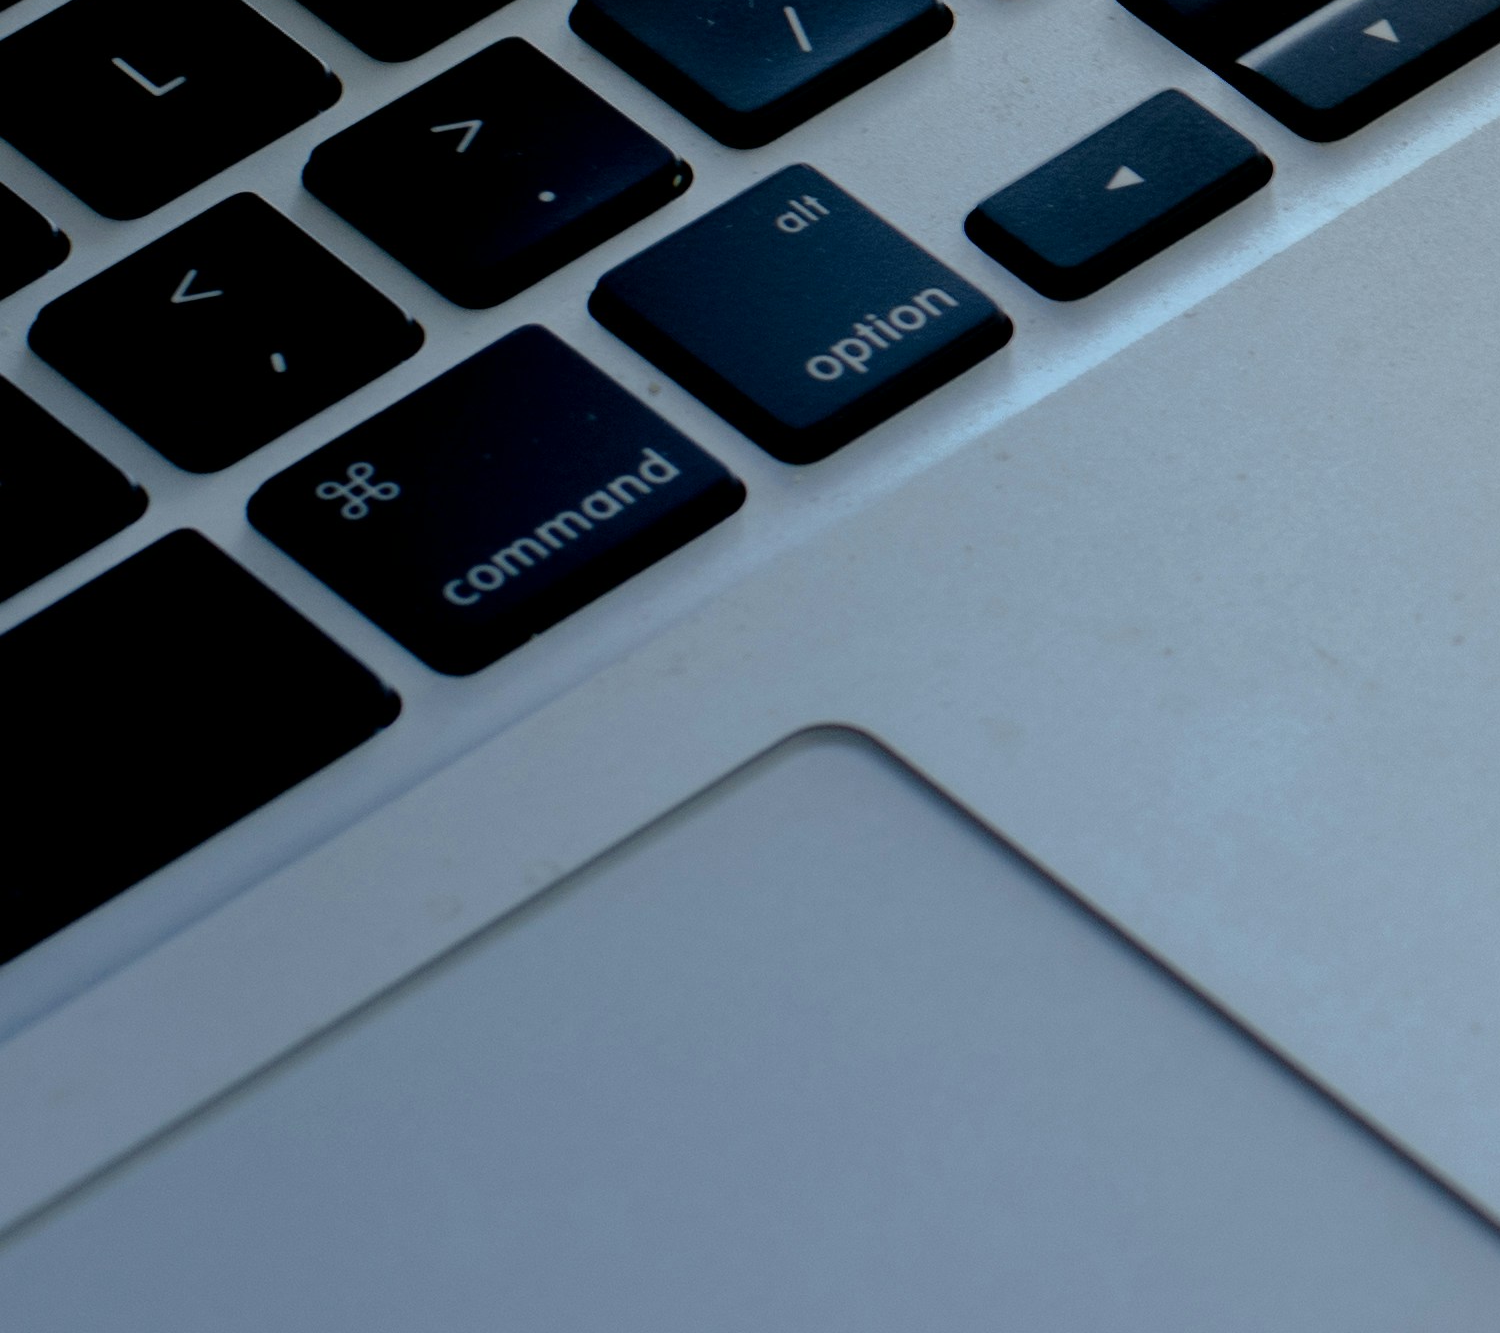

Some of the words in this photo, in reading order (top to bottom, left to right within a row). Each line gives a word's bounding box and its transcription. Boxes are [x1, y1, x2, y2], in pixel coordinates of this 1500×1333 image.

[784, 6, 813, 53] /
[111, 57, 186, 97] L
[776, 194, 830, 234] alt
[806, 287, 963, 386] option
[444, 447, 683, 610] command
